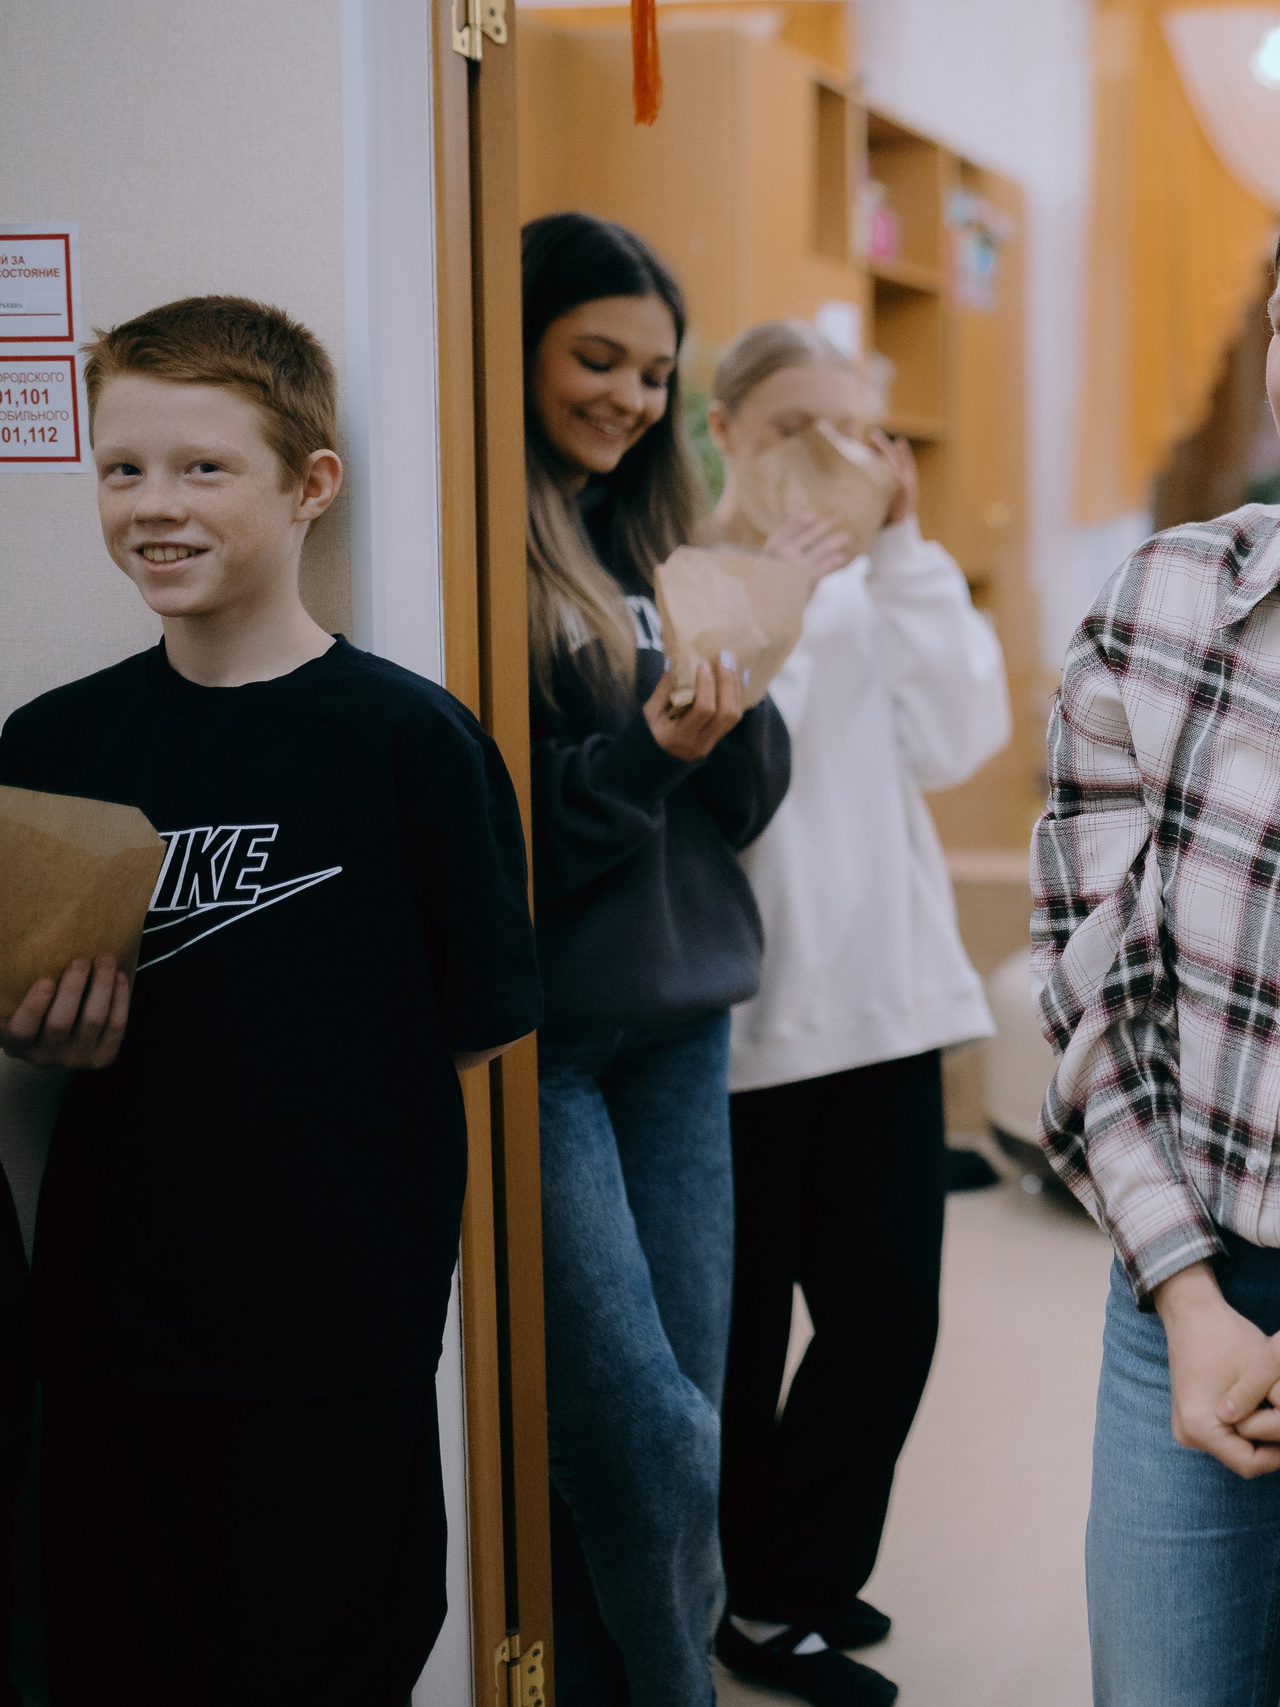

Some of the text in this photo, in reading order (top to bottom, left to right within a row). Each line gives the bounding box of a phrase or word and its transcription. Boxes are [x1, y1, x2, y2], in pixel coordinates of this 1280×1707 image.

[11, 255, 25, 265] ЗА
[0, 268, 60, 279] ОСТОЯНИЕ
[0, 388, 49, 407] 1,101
[1, 426, 58, 446] 01,112
[148, 824, 279, 911] IKE
